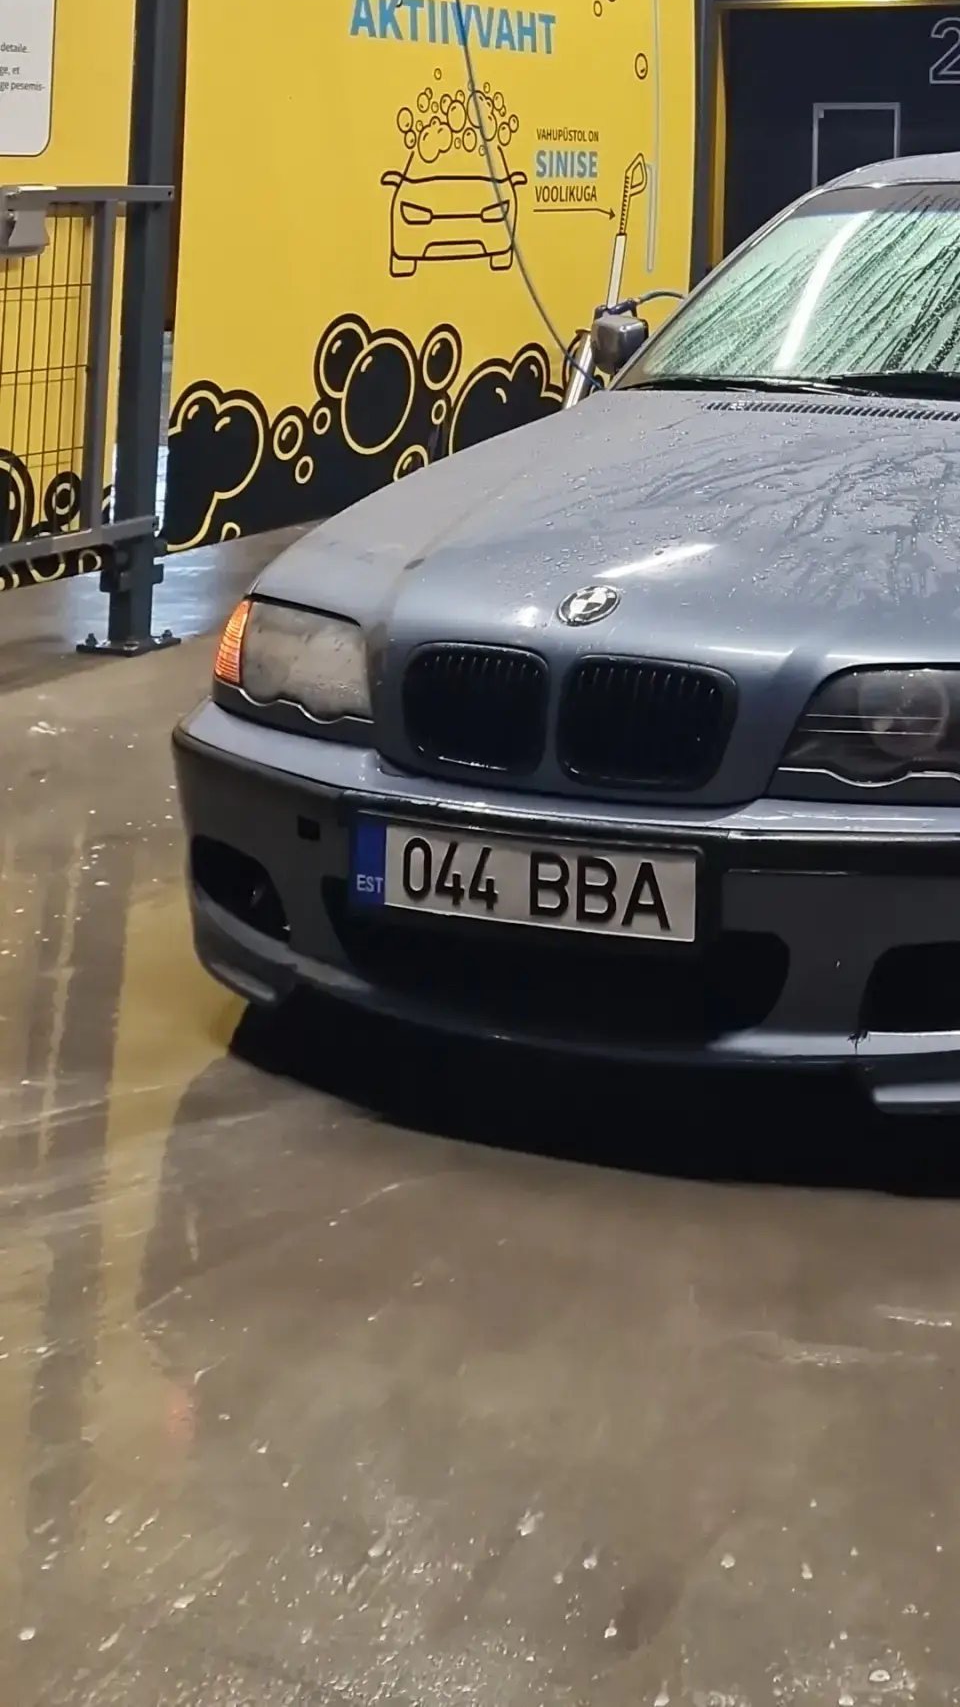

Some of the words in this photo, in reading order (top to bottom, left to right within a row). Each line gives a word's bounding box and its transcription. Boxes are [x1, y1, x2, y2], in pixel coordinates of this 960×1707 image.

[536, 127, 587, 142] VAHUPÜSTOL
[588, 131, 599, 142] ON
[536, 150, 598, 178] SINISE
[535, 185, 597, 202] VOOLIKUGA
[357, 874, 384, 893] EST
[402, 836, 498, 910] 044
[530, 851, 671, 931] BBA
